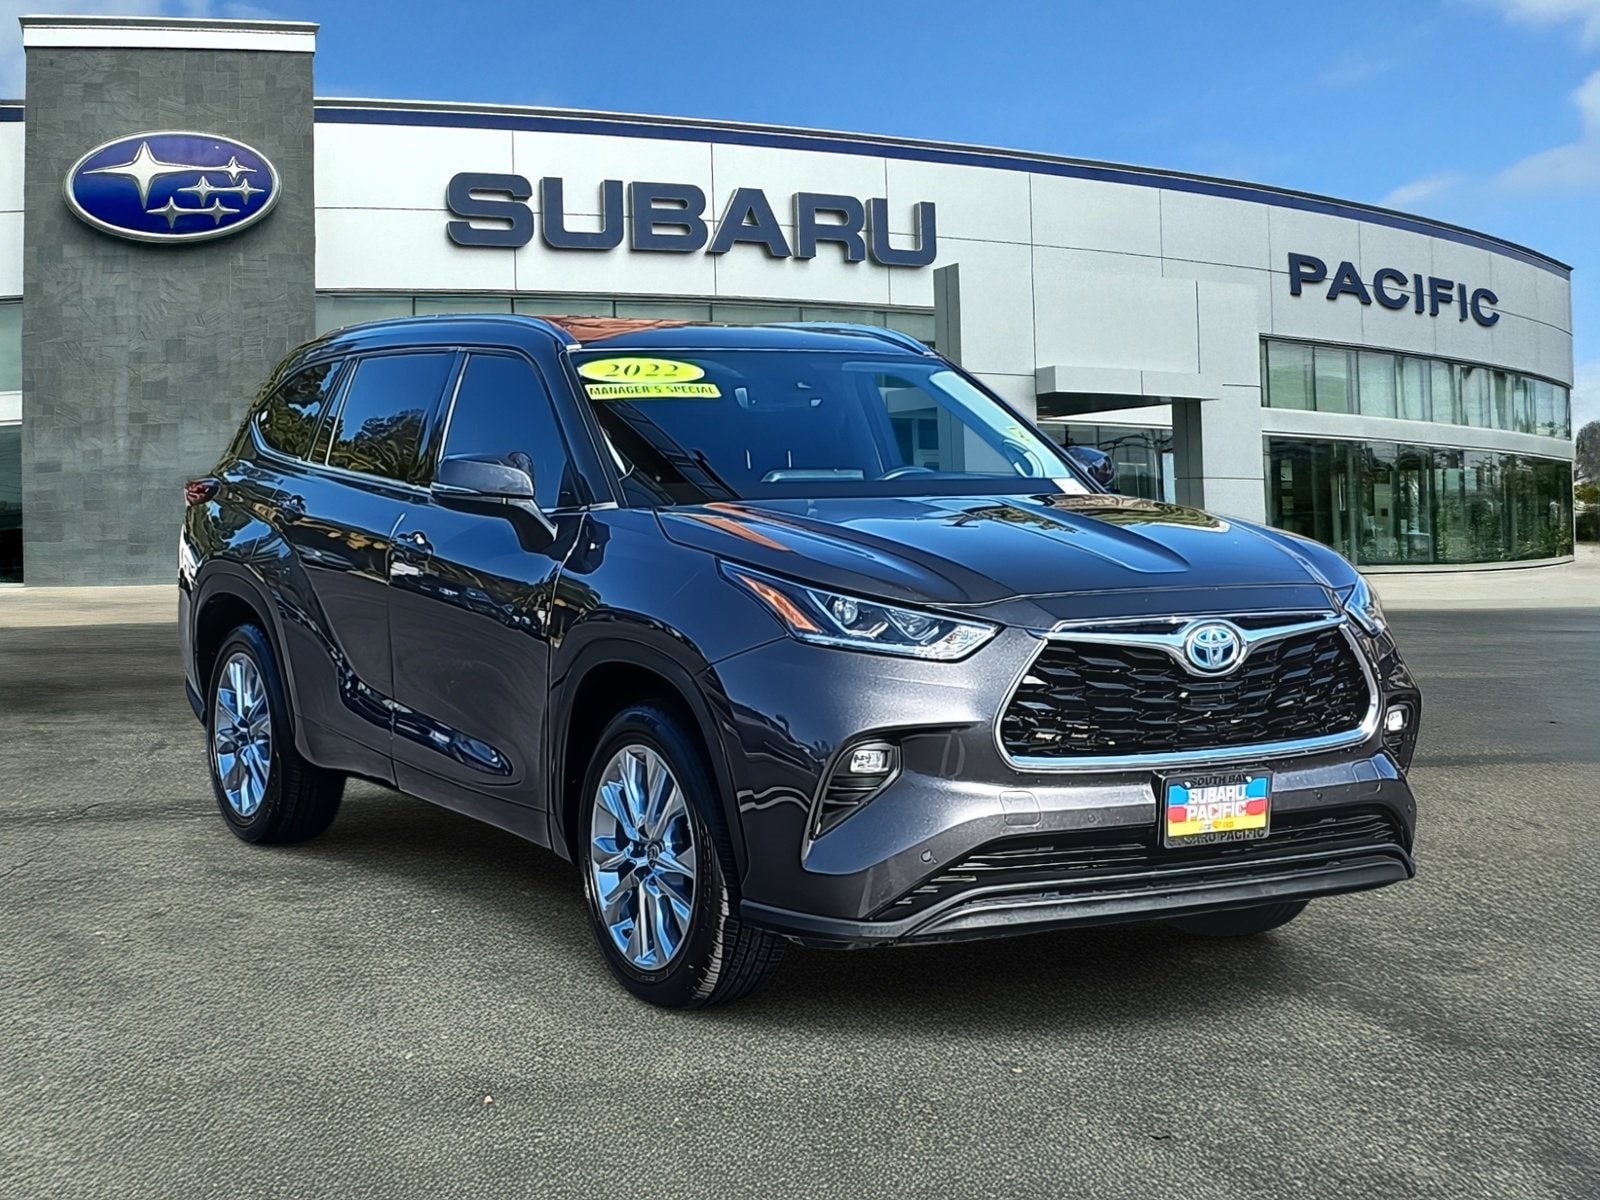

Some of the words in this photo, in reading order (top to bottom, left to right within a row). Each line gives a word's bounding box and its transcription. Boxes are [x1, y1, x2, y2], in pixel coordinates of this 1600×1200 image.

[446, 171, 937, 269] SUBARU
[1288, 251, 1500, 327] PACIFIC
[605, 364, 678, 377] 2022
[589, 384, 662, 396] MANAGER'S
[666, 383, 716, 395] SPECIAL
[1191, 776, 1226, 786] SOUTH
[1188, 784, 1246, 804] SUBARU
[1187, 801, 1246, 821] PACIFIC
[1220, 829, 1265, 841] PACIFIC
